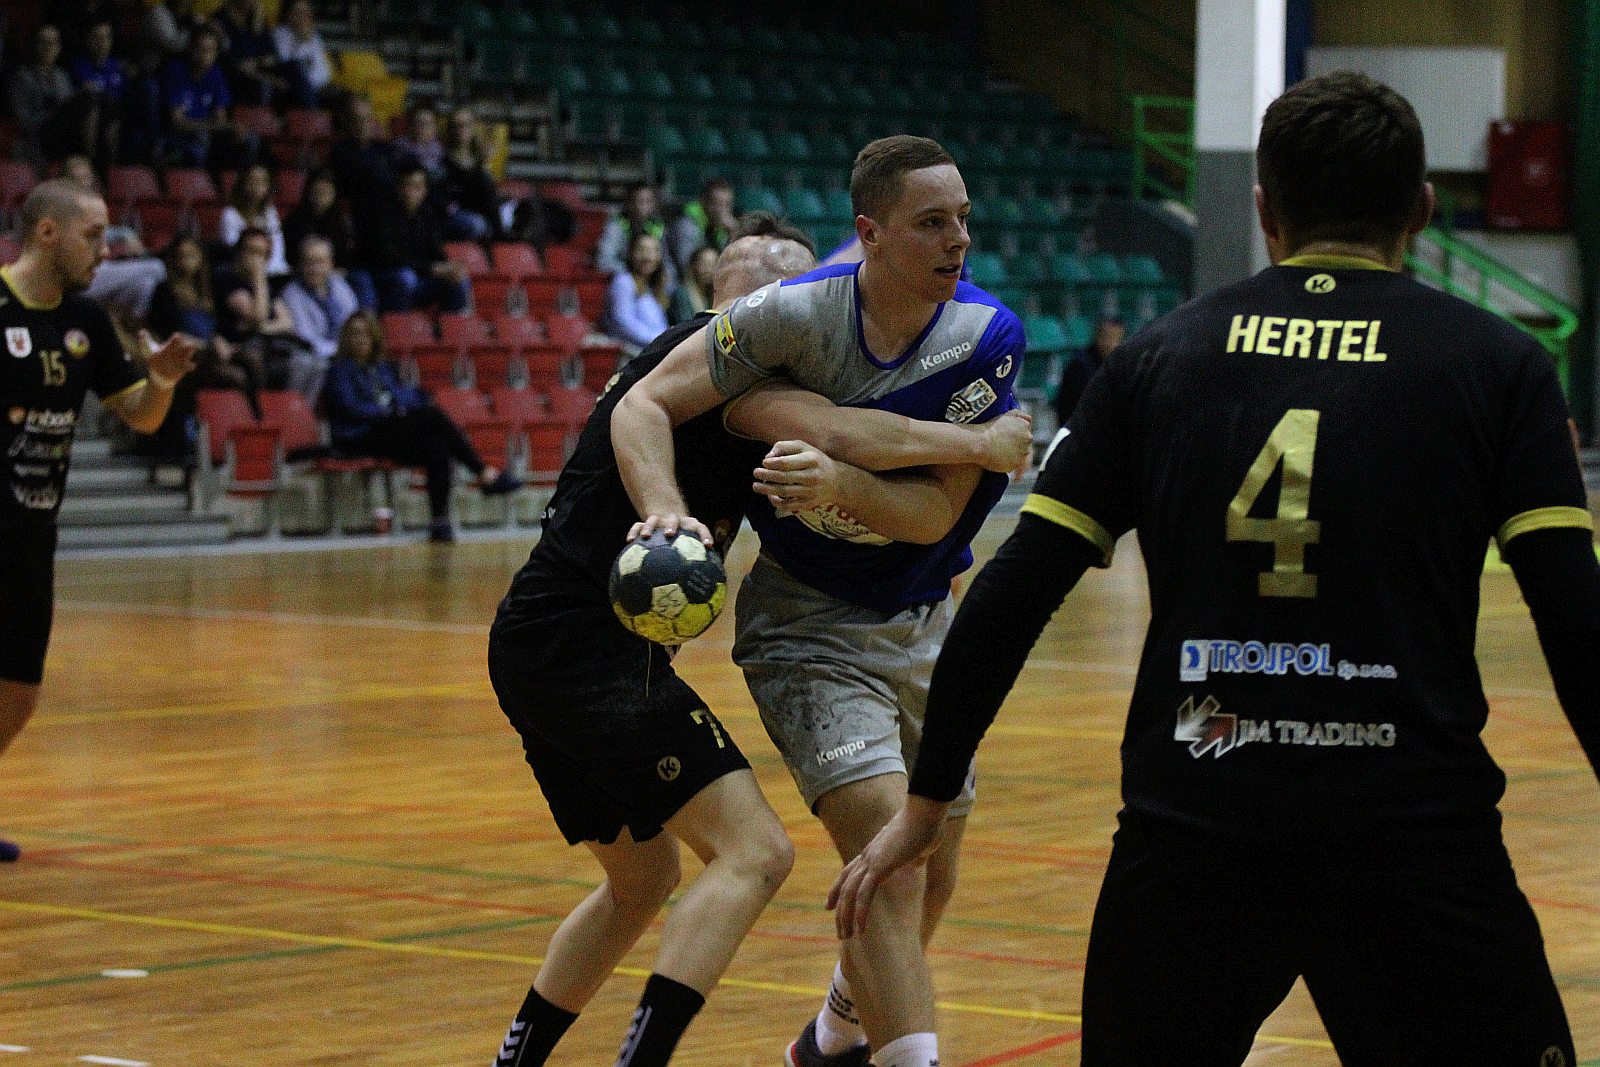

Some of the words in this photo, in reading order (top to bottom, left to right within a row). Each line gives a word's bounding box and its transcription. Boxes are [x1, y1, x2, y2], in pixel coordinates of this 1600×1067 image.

[919, 341, 973, 370] Kempa
[1225, 314, 1388, 362] HERTEL
[39, 350, 68, 386] 15
[1224, 408, 1322, 599] 4
[1208, 640, 1335, 676] TROJPOL
[689, 708, 725, 749] 7
[1274, 720, 1397, 747] TRADING
[815, 738, 867, 767] Kempa
